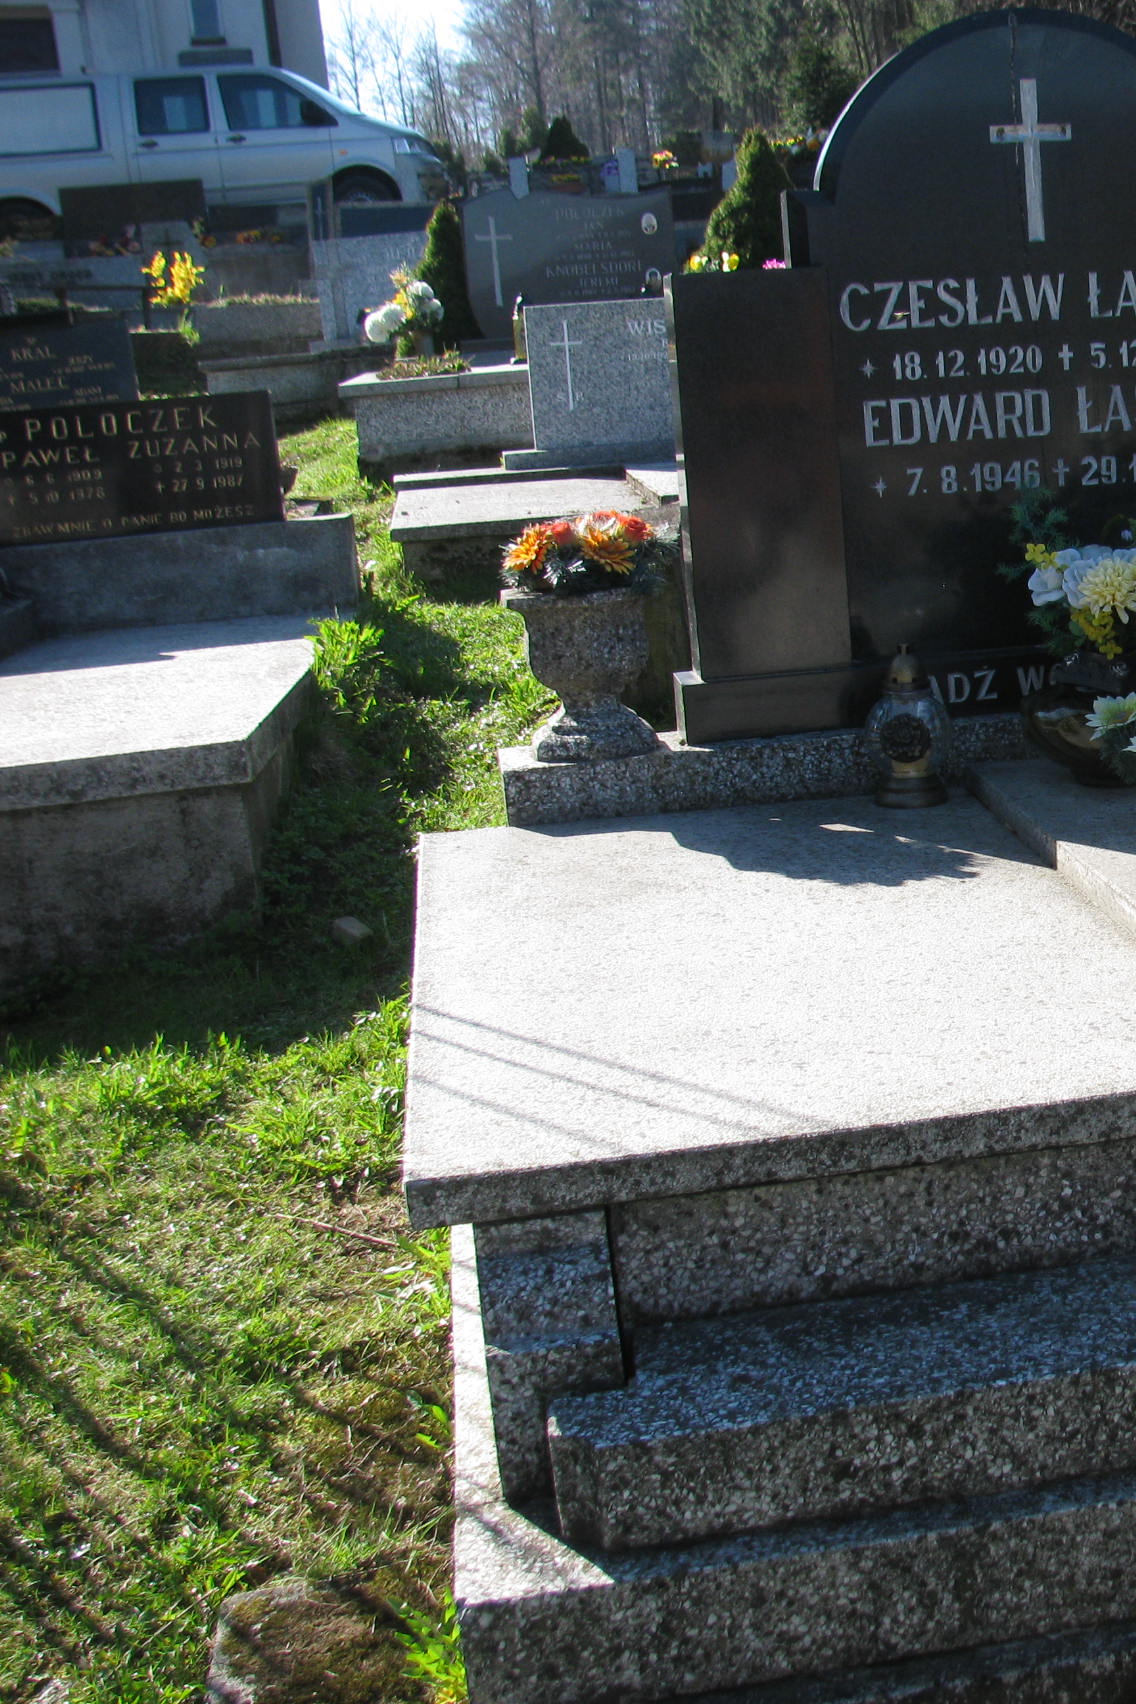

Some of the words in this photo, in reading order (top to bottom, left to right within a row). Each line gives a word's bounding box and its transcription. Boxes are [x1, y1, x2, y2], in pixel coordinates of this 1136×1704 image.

[839, 272, 1065, 331] CZESŁAW
[626, 318, 667, 336] WIS
[24, 404, 220, 441] POLOCZEK
[862, 387, 1051, 449] EDWARD
[128, 432, 261, 459] ZUZANNA
